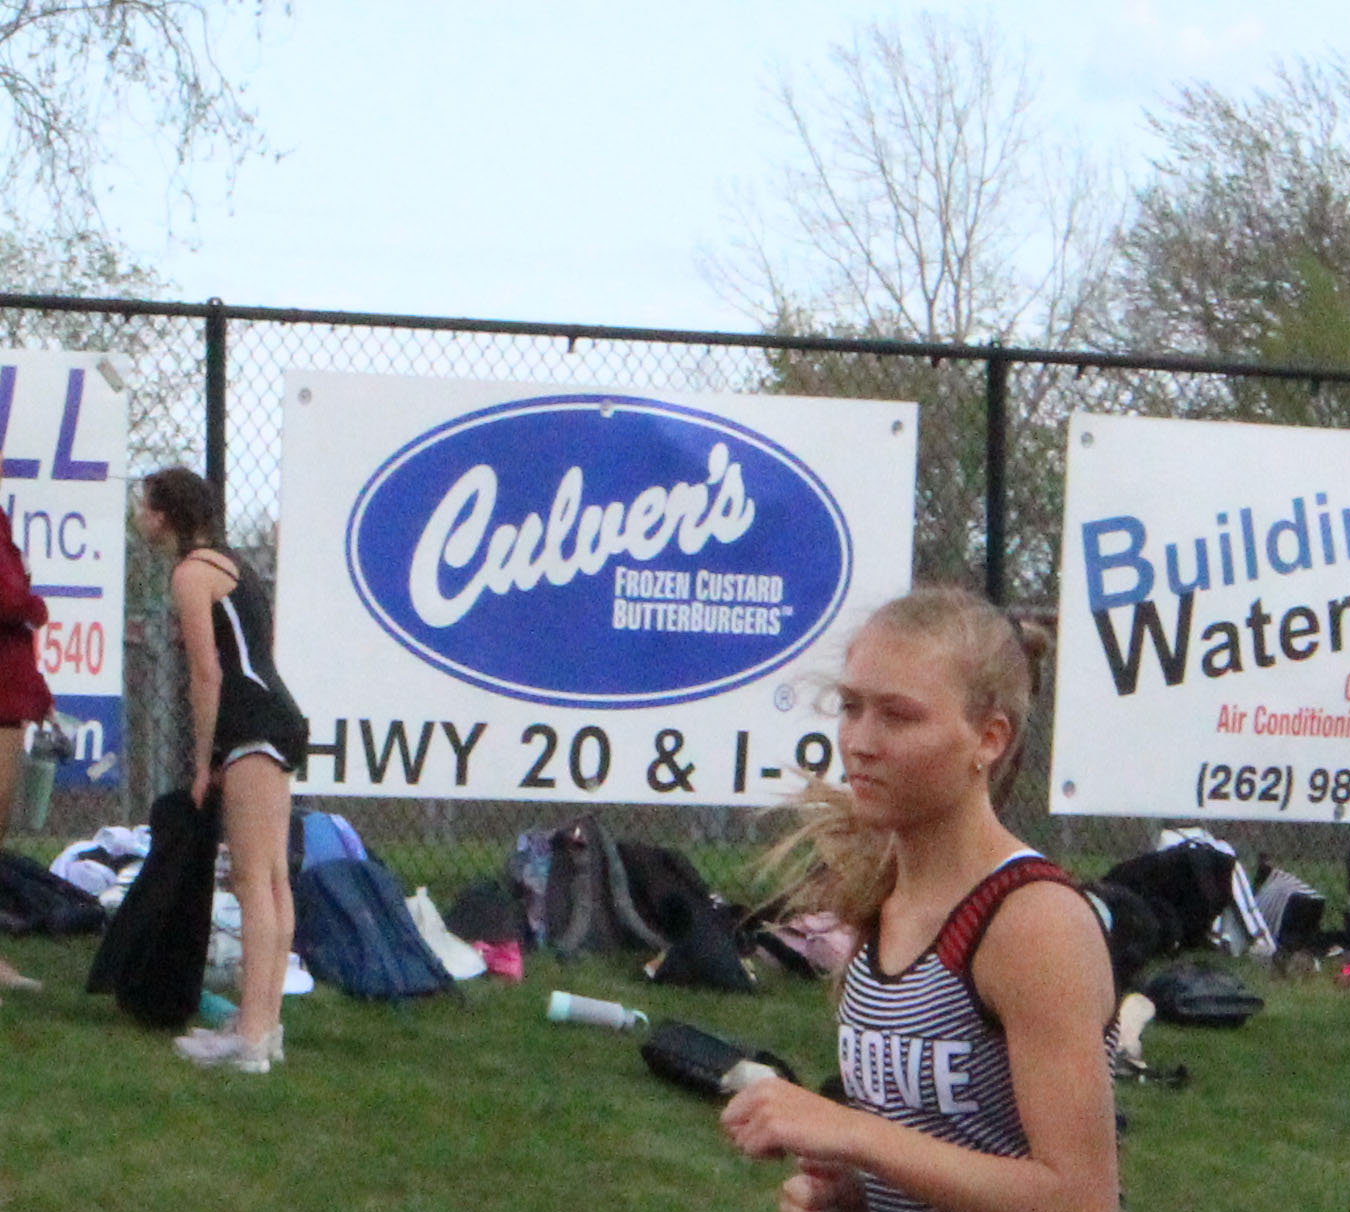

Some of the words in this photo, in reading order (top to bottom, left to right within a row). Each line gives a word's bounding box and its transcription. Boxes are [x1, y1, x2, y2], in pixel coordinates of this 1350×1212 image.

[409, 442, 755, 628] Culver's
[615, 566, 690, 600] FROZEN
[695, 569, 784, 603] CUSTARD
[34, 621, 104, 675] 540
[1217, 704, 1247, 734] Air
[296, 717, 488, 788] HWY
[518, 723, 613, 790] 20
[647, 728, 696, 793] &
[733, 730, 849, 793] I-9
[1196, 762, 1294, 811] (262)
